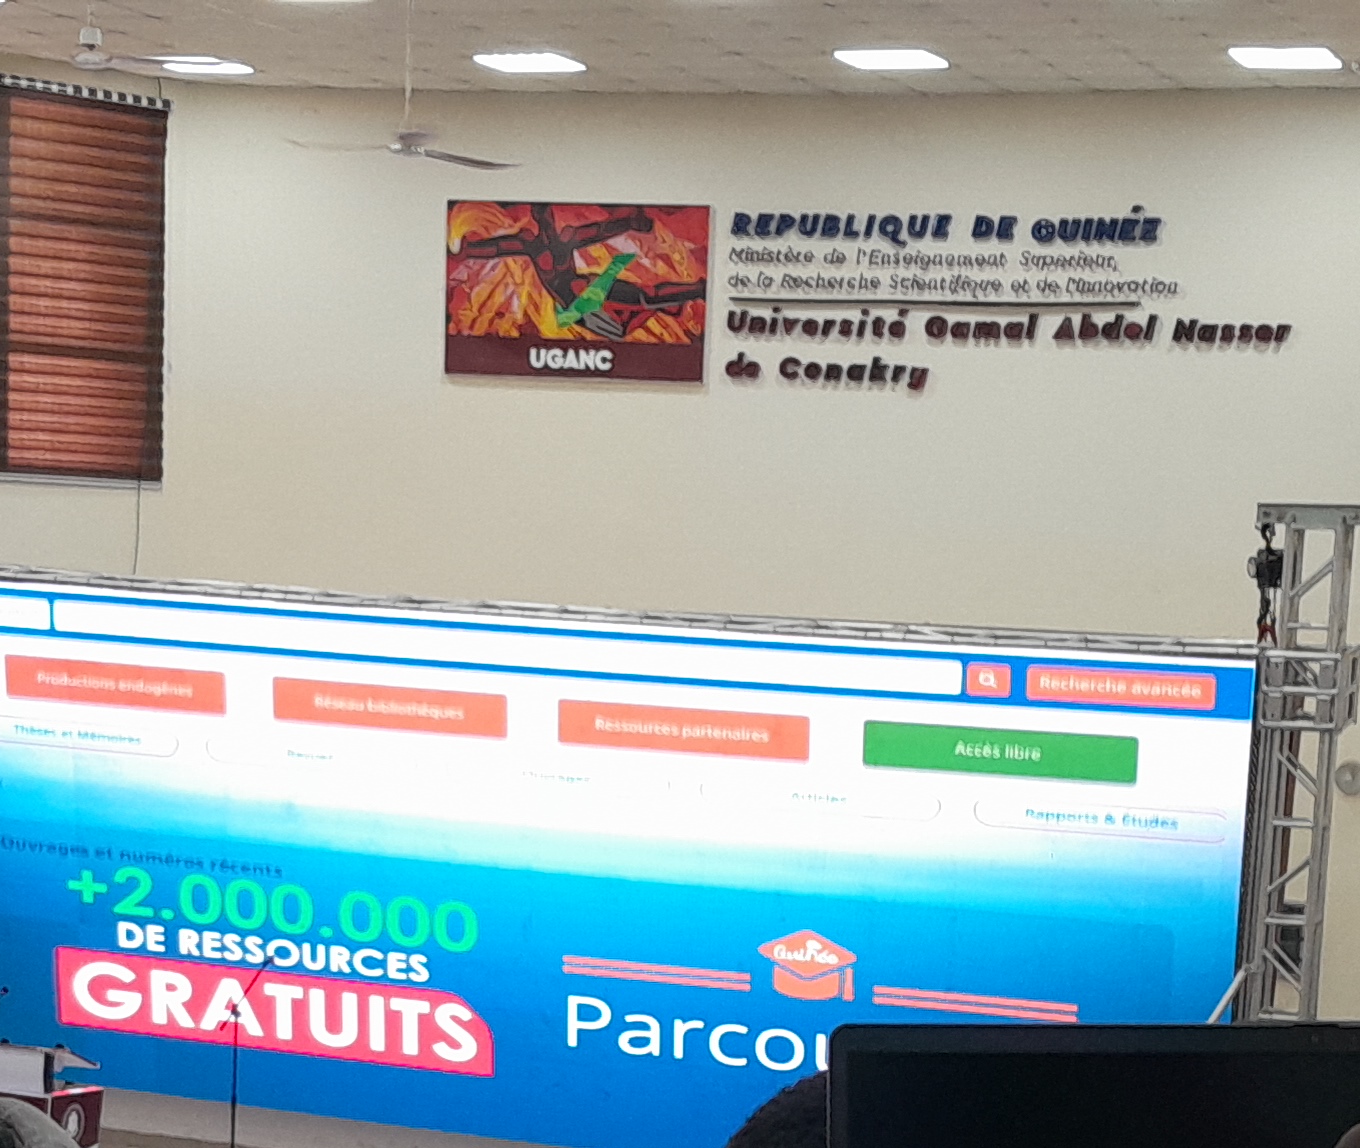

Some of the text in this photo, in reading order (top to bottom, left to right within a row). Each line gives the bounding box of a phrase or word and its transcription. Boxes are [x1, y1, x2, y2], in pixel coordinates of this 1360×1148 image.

[730, 211, 954, 248] REPUBLIQUE
[971, 214, 1018, 241] DE
[823, 247, 846, 265] de
[728, 271, 753, 288] de
[1036, 277, 1060, 295] de
[727, 305, 907, 340] Université
[1052, 313, 1159, 342] Abdel
[1171, 317, 1293, 344] Nasser
[528, 346, 615, 372] UGANC
[725, 351, 930, 392] de Conakry
[36, 668, 116, 692] Productions
[1038, 673, 1127, 696] Recherche
[594, 714, 770, 744] Ressources partenaires
[1004, 742, 1042, 763] libre
[66, 865, 479, 954] +2.000.000
[117, 921, 430, 983] DE RESSOURCES
[72, 961, 478, 1063] GRATUITS
